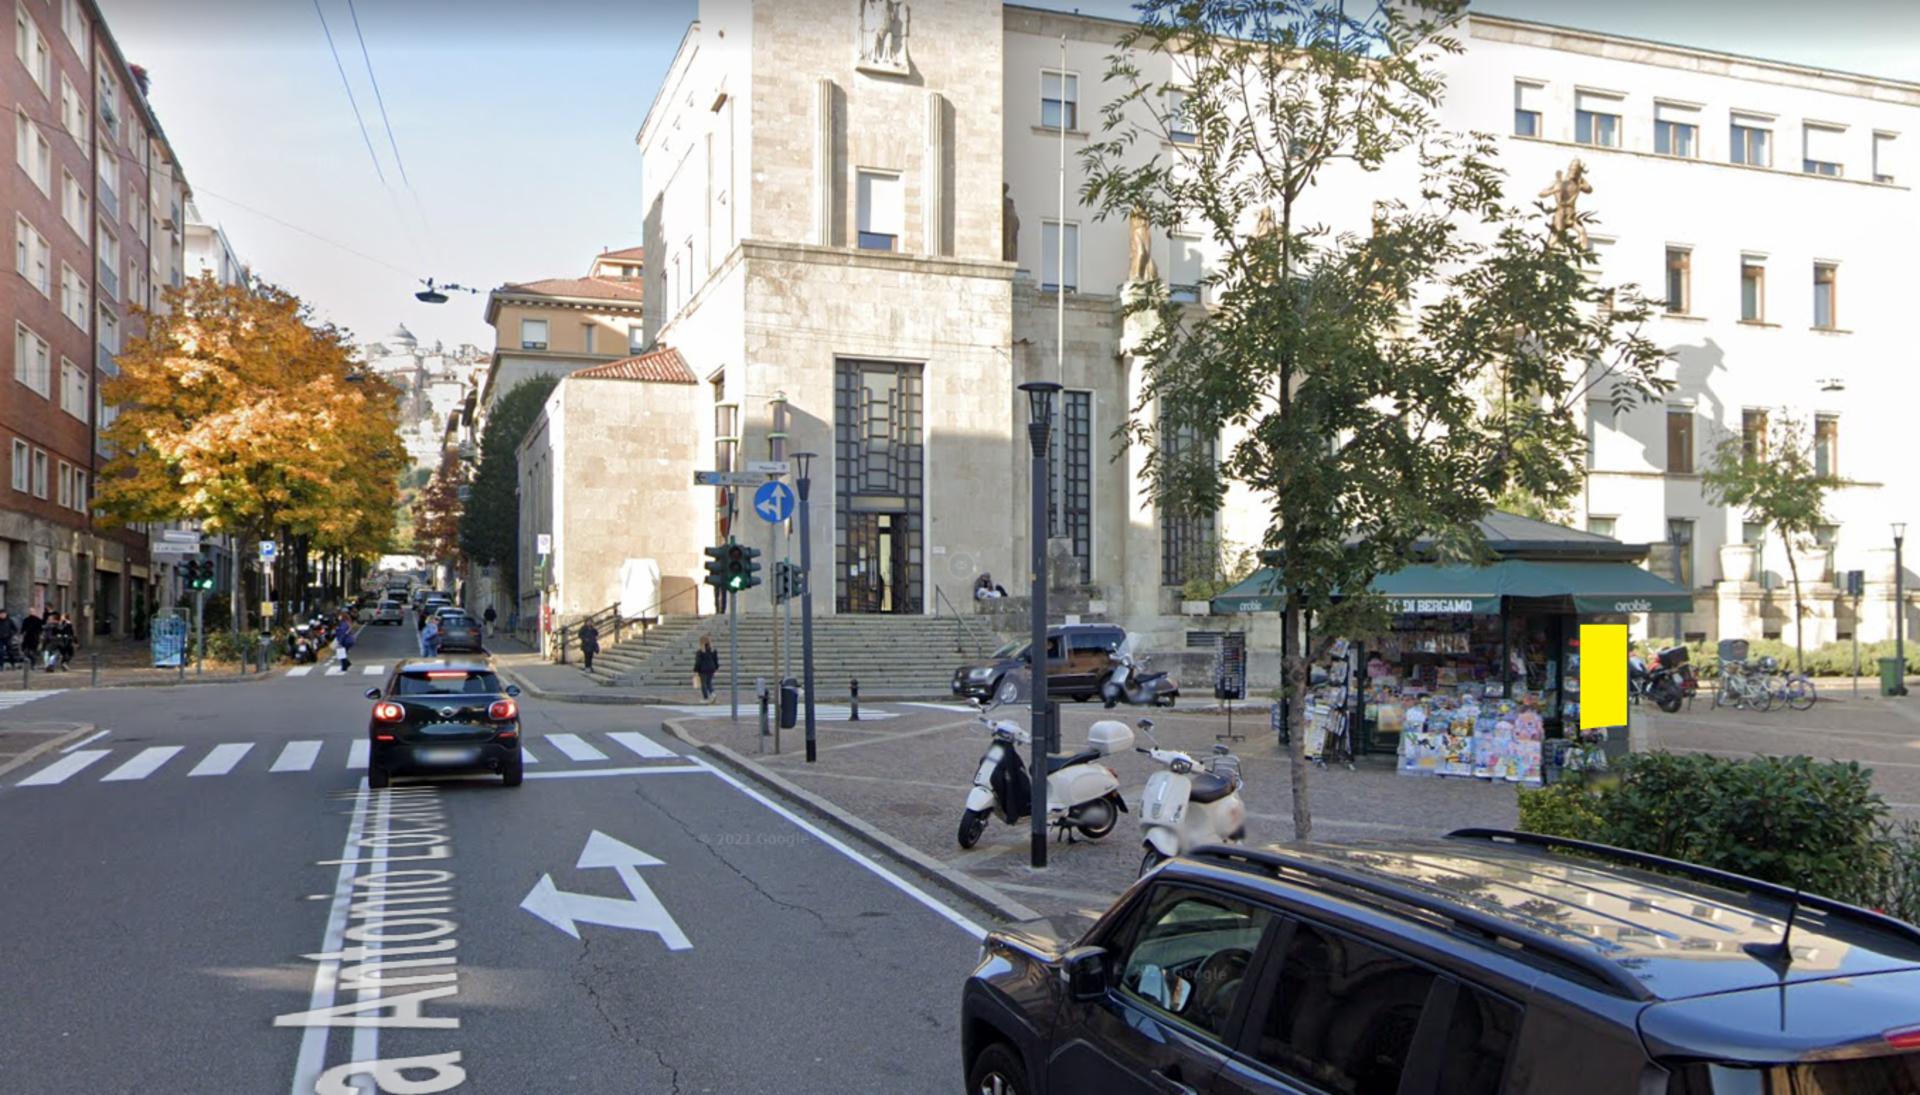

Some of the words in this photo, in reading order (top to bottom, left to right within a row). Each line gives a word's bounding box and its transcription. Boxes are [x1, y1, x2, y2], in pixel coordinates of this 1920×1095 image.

[1402, 599, 1415, 612] DI
[1417, 599, 1473, 612] BERGAMO
[1615, 599, 1652, 611] orobie
